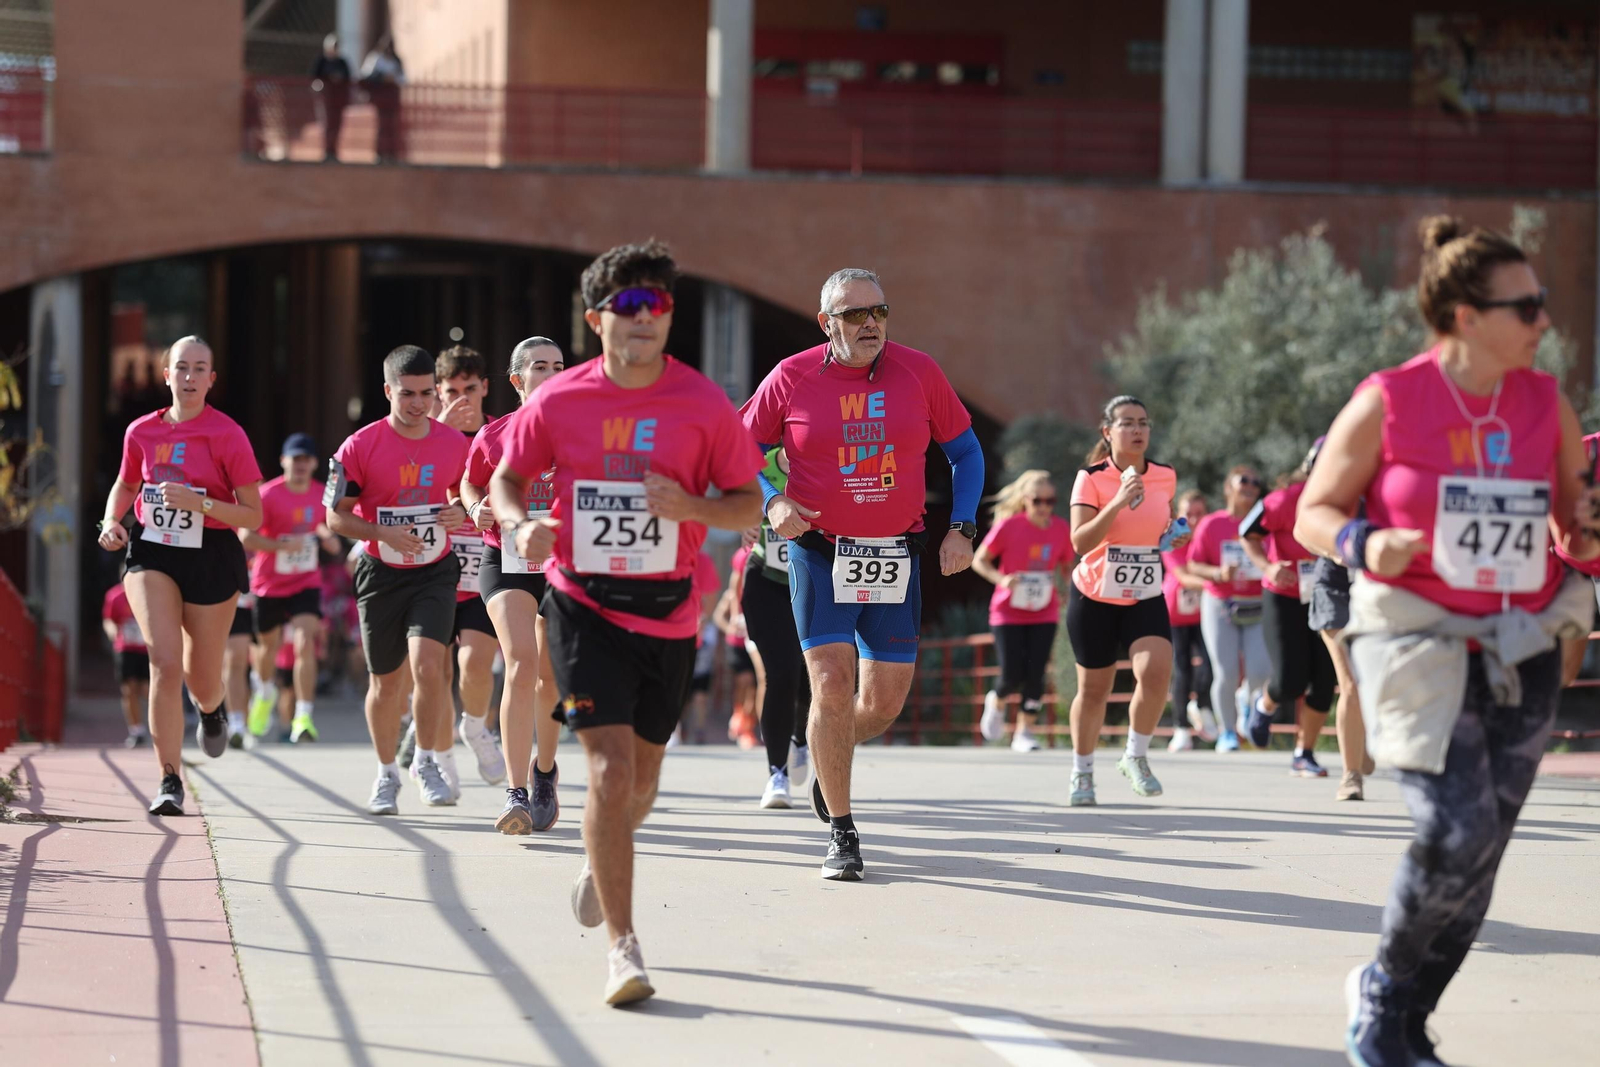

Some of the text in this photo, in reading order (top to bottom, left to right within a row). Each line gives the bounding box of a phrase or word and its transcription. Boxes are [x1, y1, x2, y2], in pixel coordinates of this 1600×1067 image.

[839, 391, 886, 420] WE
[603, 418, 657, 451] WE
[846, 423, 882, 441] RUN
[154, 442, 186, 465] WE
[1448, 428, 1513, 466] WE
[838, 444, 897, 475] UMA
[399, 464, 434, 487] WE
[144, 494, 164, 505] UM
[527, 483, 553, 498] UN
[580, 496, 625, 510] UMA
[153, 507, 193, 529] 673
[381, 516, 410, 526] UMA
[593, 516, 662, 547] 254
[1458, 520, 1534, 557] 474
[840, 545, 874, 557] UMA
[1109, 553, 1136, 563] UMA
[845, 560, 899, 584] 393
[1115, 565, 1155, 585] 678
[857, 592, 869, 600] WE
